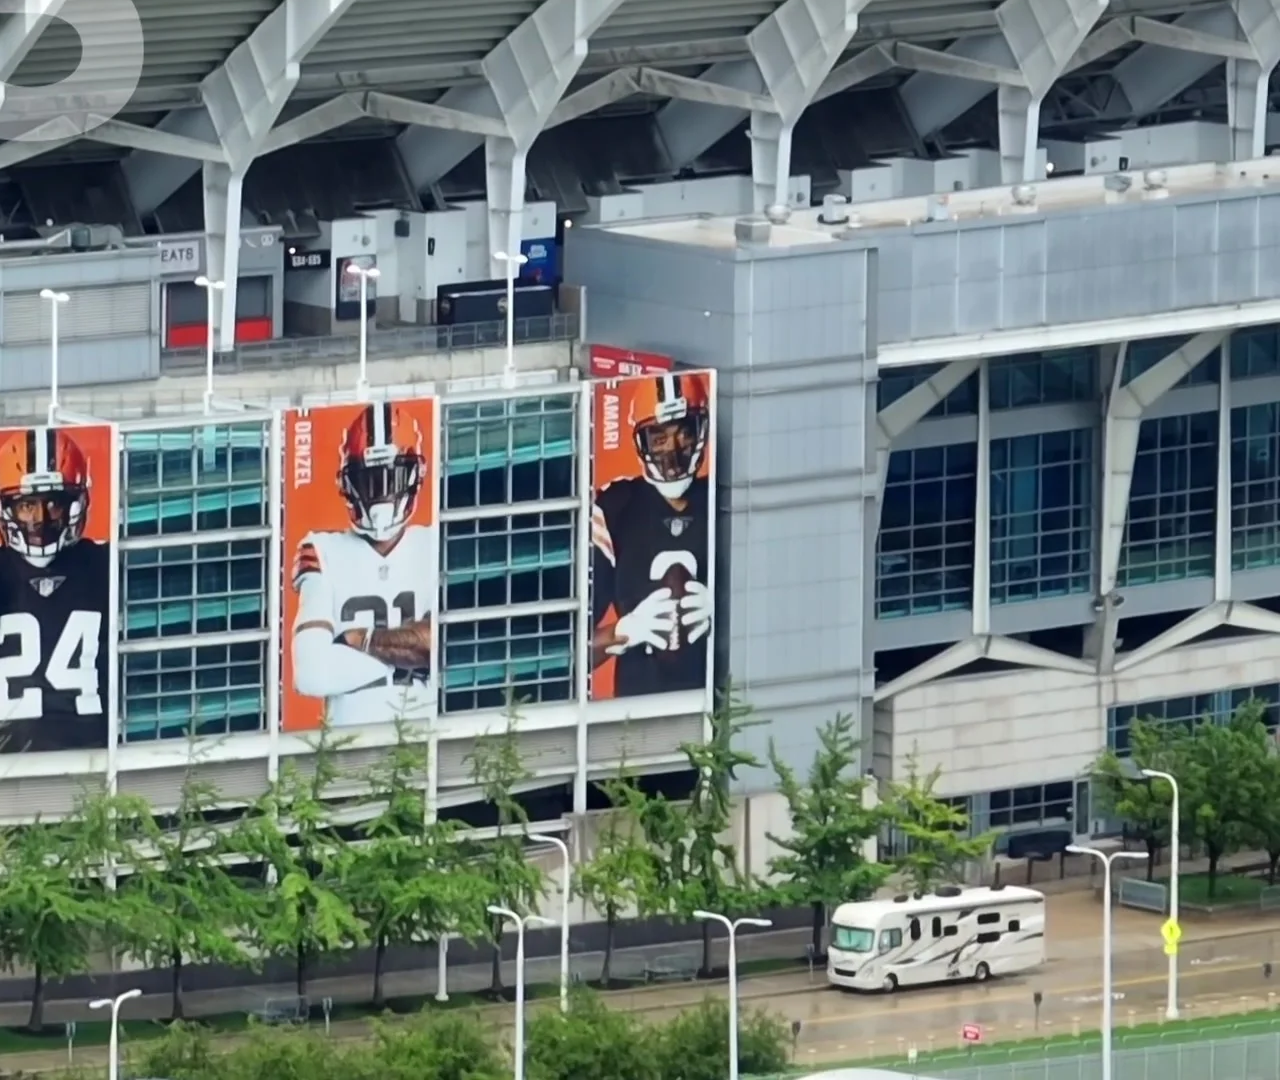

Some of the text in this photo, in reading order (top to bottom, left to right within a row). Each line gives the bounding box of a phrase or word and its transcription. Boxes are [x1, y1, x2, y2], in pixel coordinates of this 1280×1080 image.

[161, 247, 194, 262] EATS
[603, 394, 620, 450] AMARI
[294, 420, 312, 489] DENZEL
